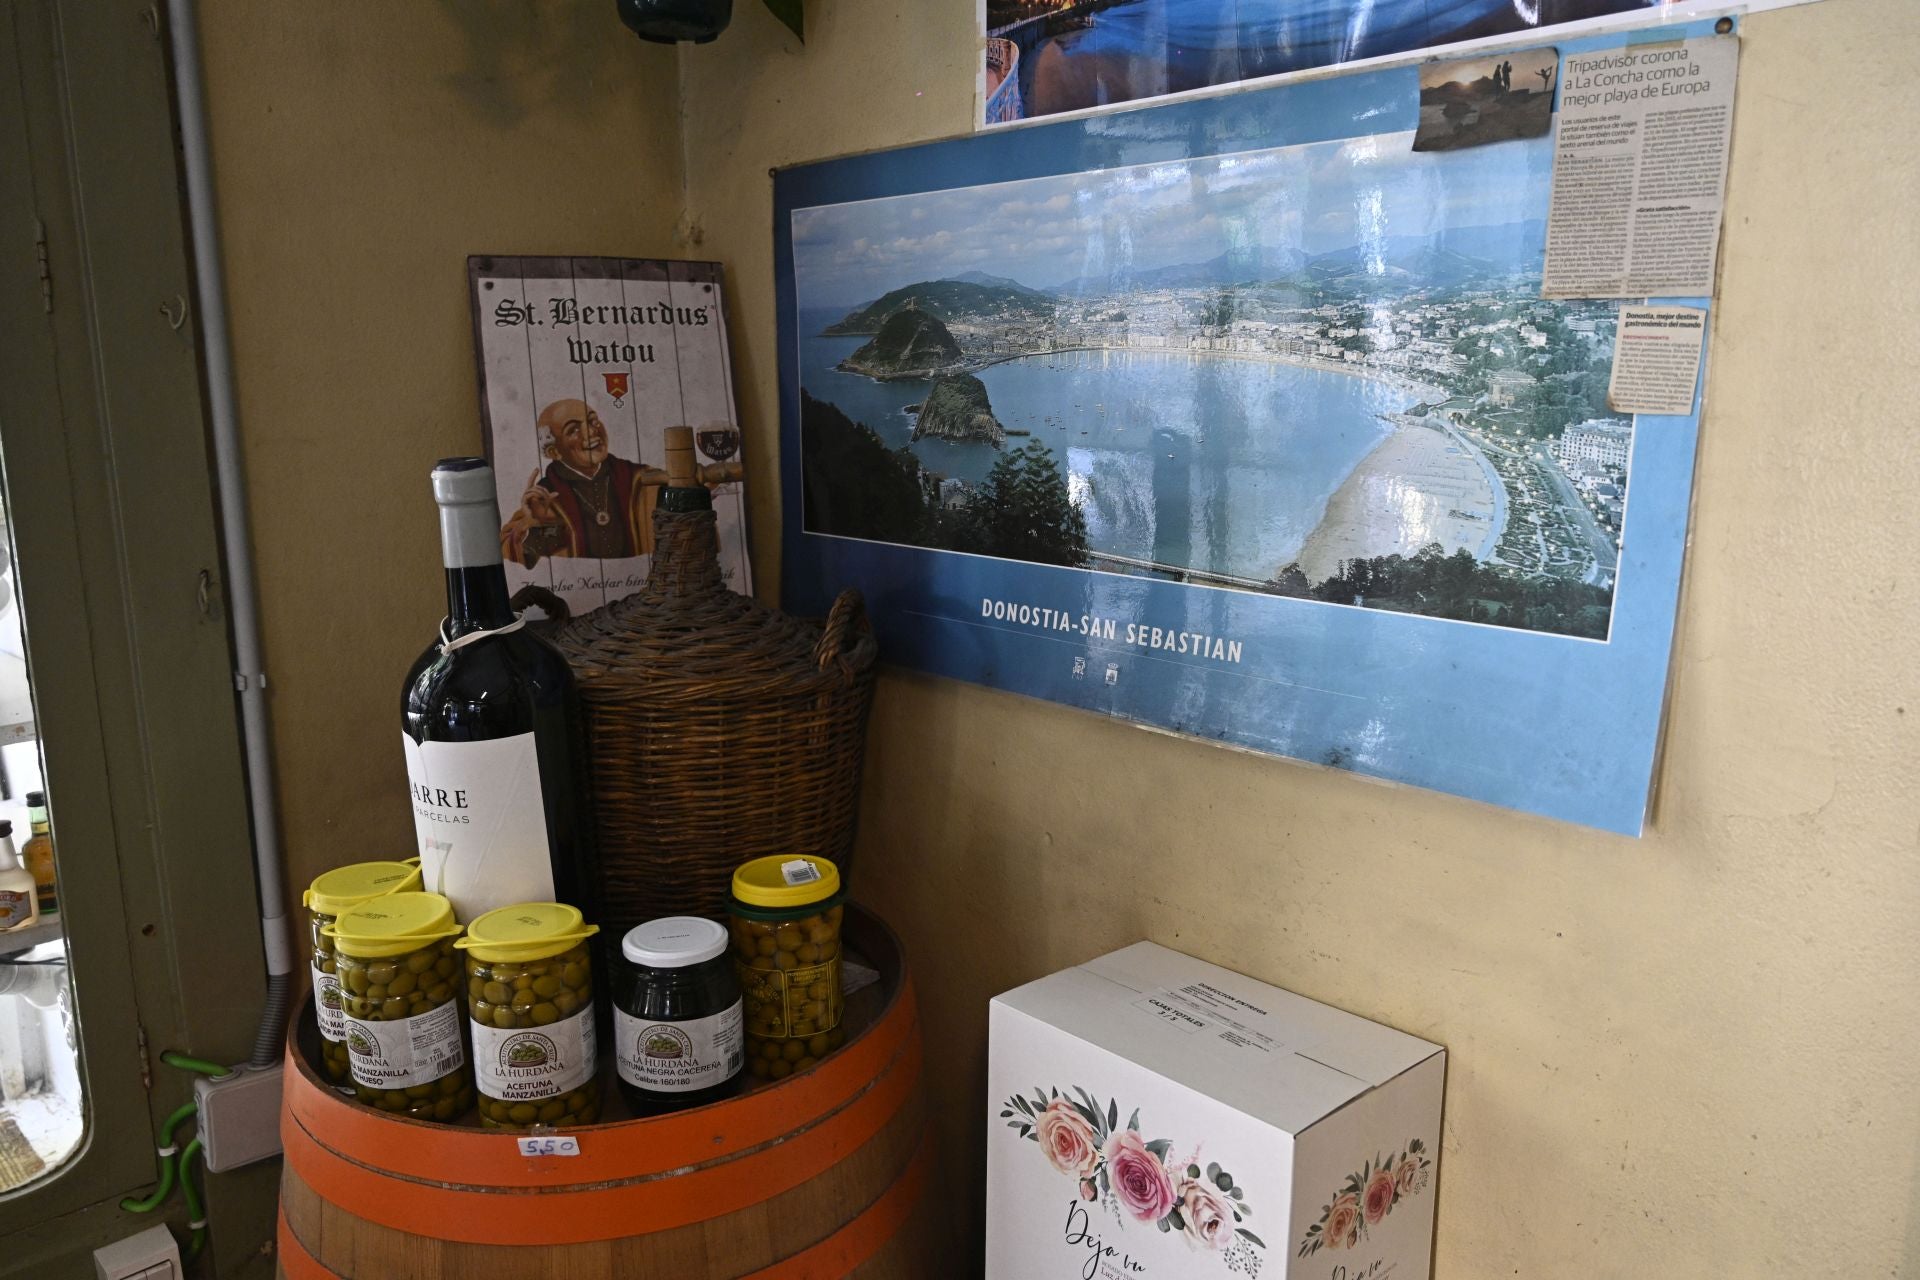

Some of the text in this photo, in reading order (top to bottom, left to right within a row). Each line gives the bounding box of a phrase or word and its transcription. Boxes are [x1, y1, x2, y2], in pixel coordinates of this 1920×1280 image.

[1568, 49, 1688, 75] Tripadvisor corona
[1564, 62, 1700, 90] a La Concha como la
[1564, 80, 1710, 108] mejor playa de Europa
[494, 297, 709, 330] St. Bernardus
[566, 335, 656, 364] Watou
[982, 598, 1243, 663] DONOSTIA-SAN SEBASTIAN
[410, 781, 468, 808] ARRE
[1148, 999, 1172, 1012] CAJAS
[1172, 1010, 1206, 1028] TOTALES
[357, 1065, 410, 1077] MANZANILLA
[495, 1062, 564, 1078] LA HURDANA
[632, 1054, 699, 1068] LA HURDANA
[646, 1067, 676, 1076] NEGRA
[678, 1060, 722, 1076] CACEREÑA
[360, 1075, 384, 1086] HUESO
[502, 1086, 562, 1099] MANZANILLA
[506, 1079, 553, 1090] ACEITUNA
[634, 1074, 690, 1086] Calibre 160/180
[1065, 1200, 1146, 1280] Deja vu
